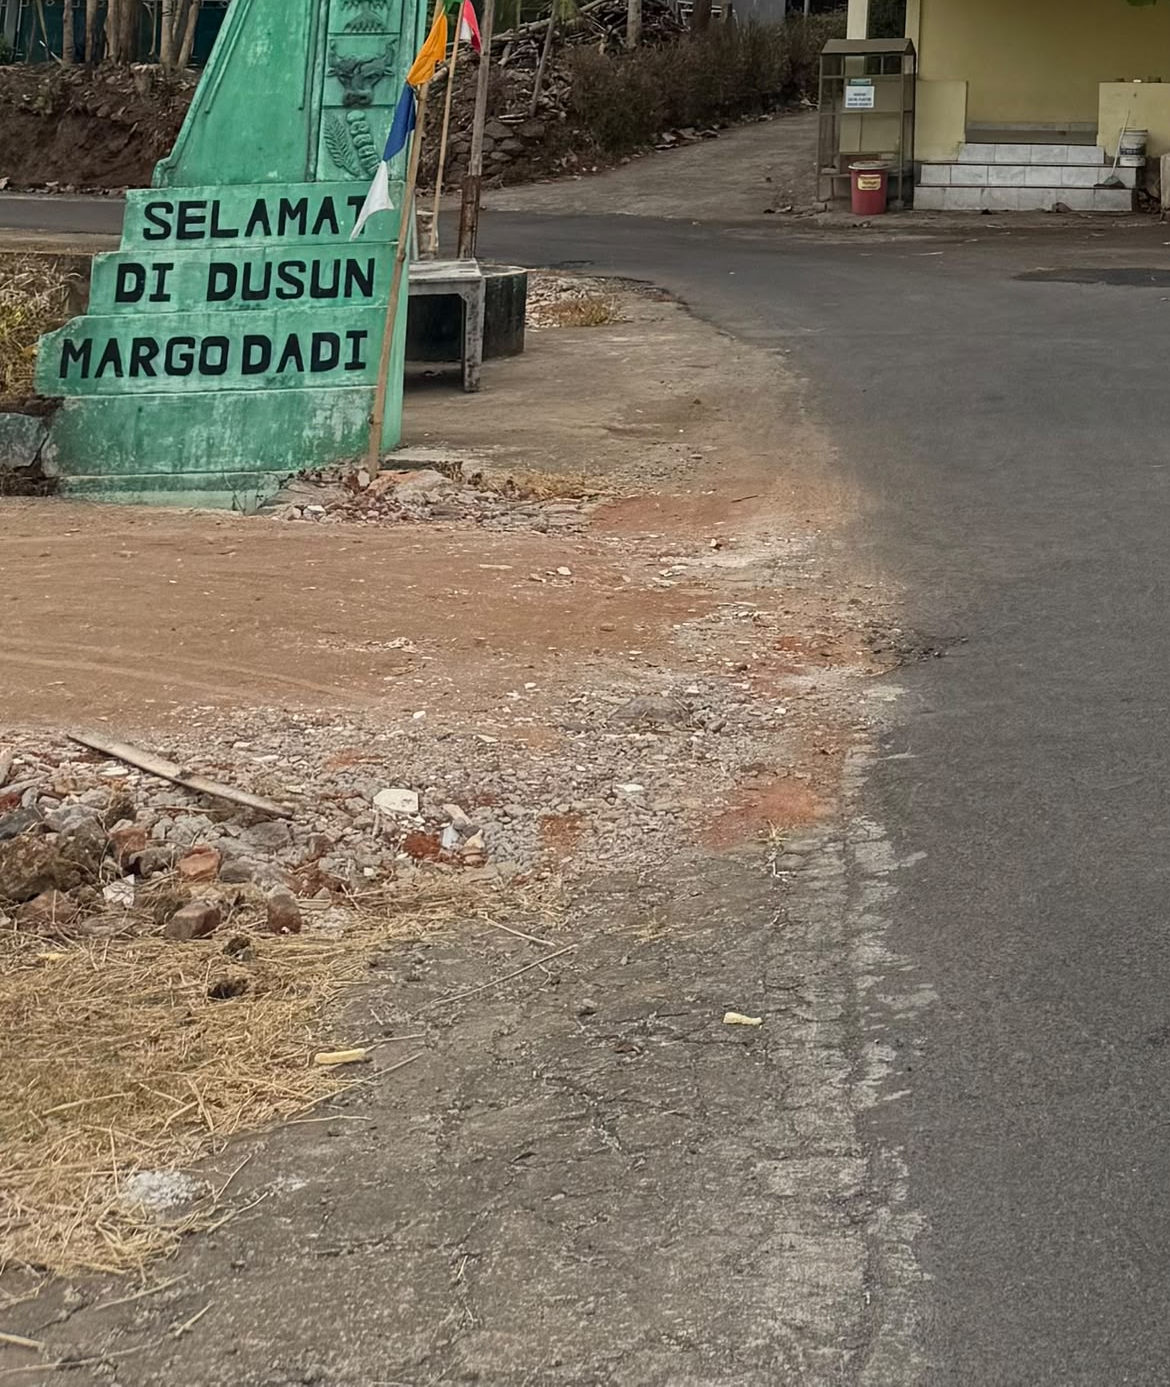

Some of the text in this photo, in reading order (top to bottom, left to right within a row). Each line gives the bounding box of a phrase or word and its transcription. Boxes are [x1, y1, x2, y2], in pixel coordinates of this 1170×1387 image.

[143, 194, 367, 241] SELAMAT
[114, 257, 375, 303] DI DUSUN
[59, 329, 368, 379] MARGODADI
